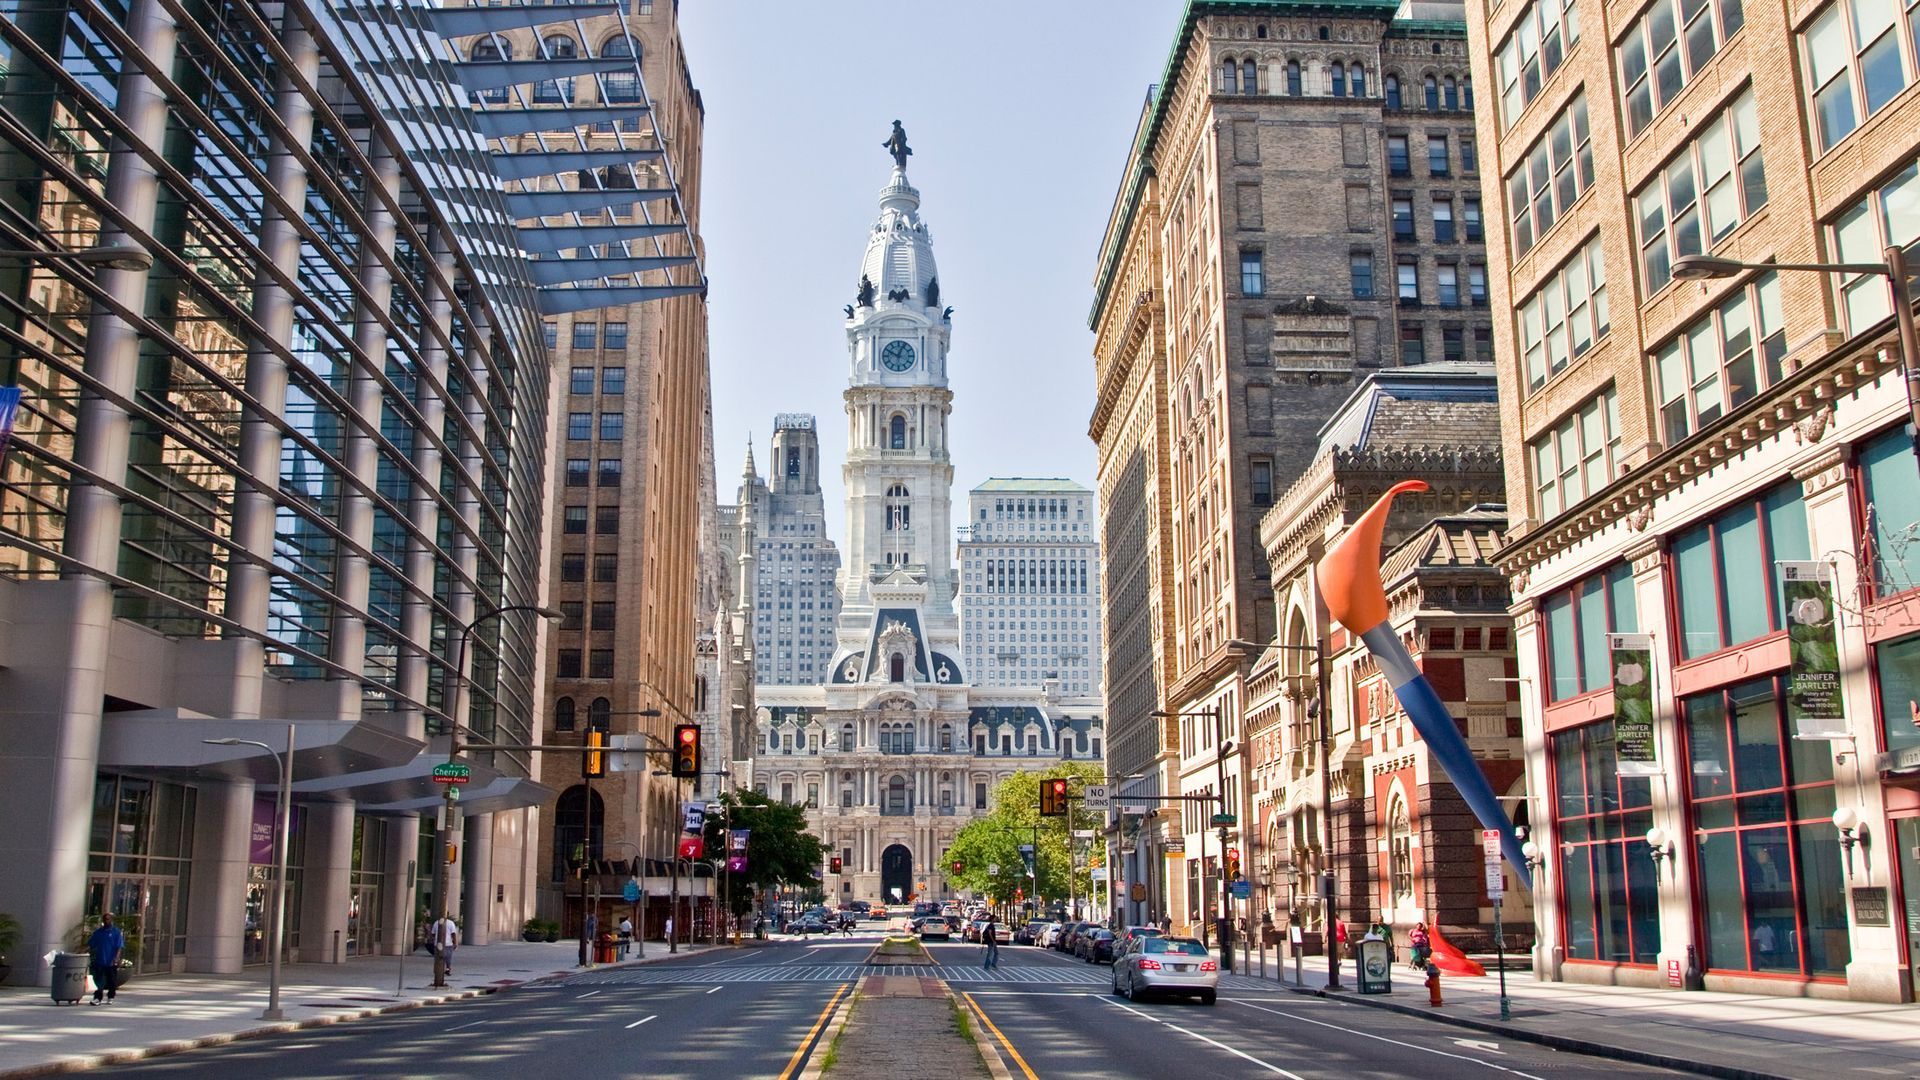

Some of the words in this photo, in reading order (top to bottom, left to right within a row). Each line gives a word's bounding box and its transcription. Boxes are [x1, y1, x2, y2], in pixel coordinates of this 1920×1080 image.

[1796, 673, 1834, 681] JENNIFER
[1796, 682, 1839, 690] BARTLETT:
[434, 767, 459, 777] Cherry
[461, 769, 469, 777] St
[1090, 788, 1104, 797] NO
[1086, 799, 1109, 807] TURNS
[1857, 910, 1885, 919] BUILDING
